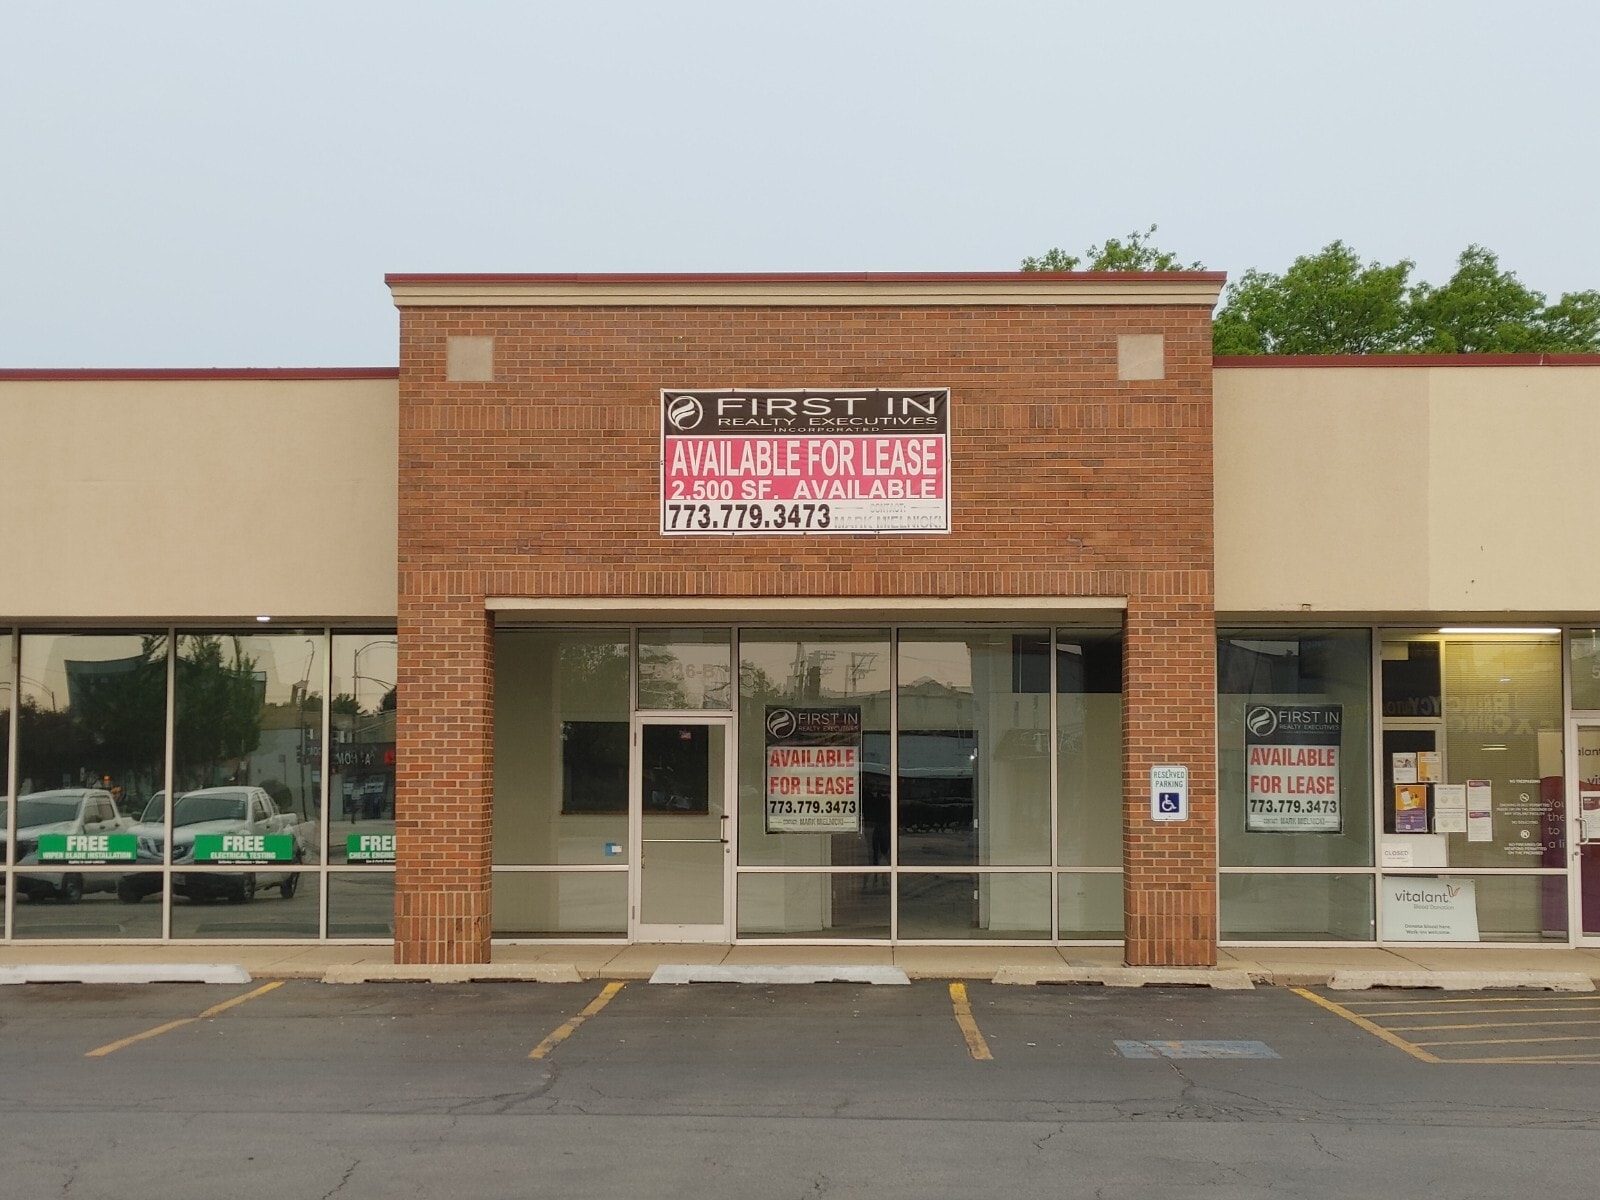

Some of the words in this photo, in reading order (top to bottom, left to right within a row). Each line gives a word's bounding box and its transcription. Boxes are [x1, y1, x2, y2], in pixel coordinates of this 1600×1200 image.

[717, 397, 867, 416] FIRST
[888, 397, 935, 415] IN
[718, 418, 796, 426] REALTY
[809, 417, 938, 426] EXECUTIVES
[671, 439, 800, 477] AVAILABLE
[808, 439, 855, 476] FOR
[862, 439, 936, 476] LEASE
[741, 480, 779, 500] SF.
[793, 479, 936, 499] AVAILABLE
[668, 503, 831, 529] 773.779.3473
[798, 713, 839, 725] FIRST
[844, 713, 858, 724] IN
[1280, 711, 1321, 723] FIRST
[1325, 711, 1339, 723] IN
[770, 749, 854, 767] AVAILABLE
[1250, 748, 1335, 766] AVAILABLE
[770, 777, 800, 794] FOR
[807, 777, 854, 794] LEASE
[1250, 776, 1282, 794] FOR
[1288, 776, 1335, 794] LEASE
[770, 801, 856, 813] 773.779.3473
[1250, 800, 1337, 813] 773.779.3473
[66, 836, 108, 851] FREE
[223, 836, 264, 851] FREE
[1395, 890, 1448, 903] vitalant
